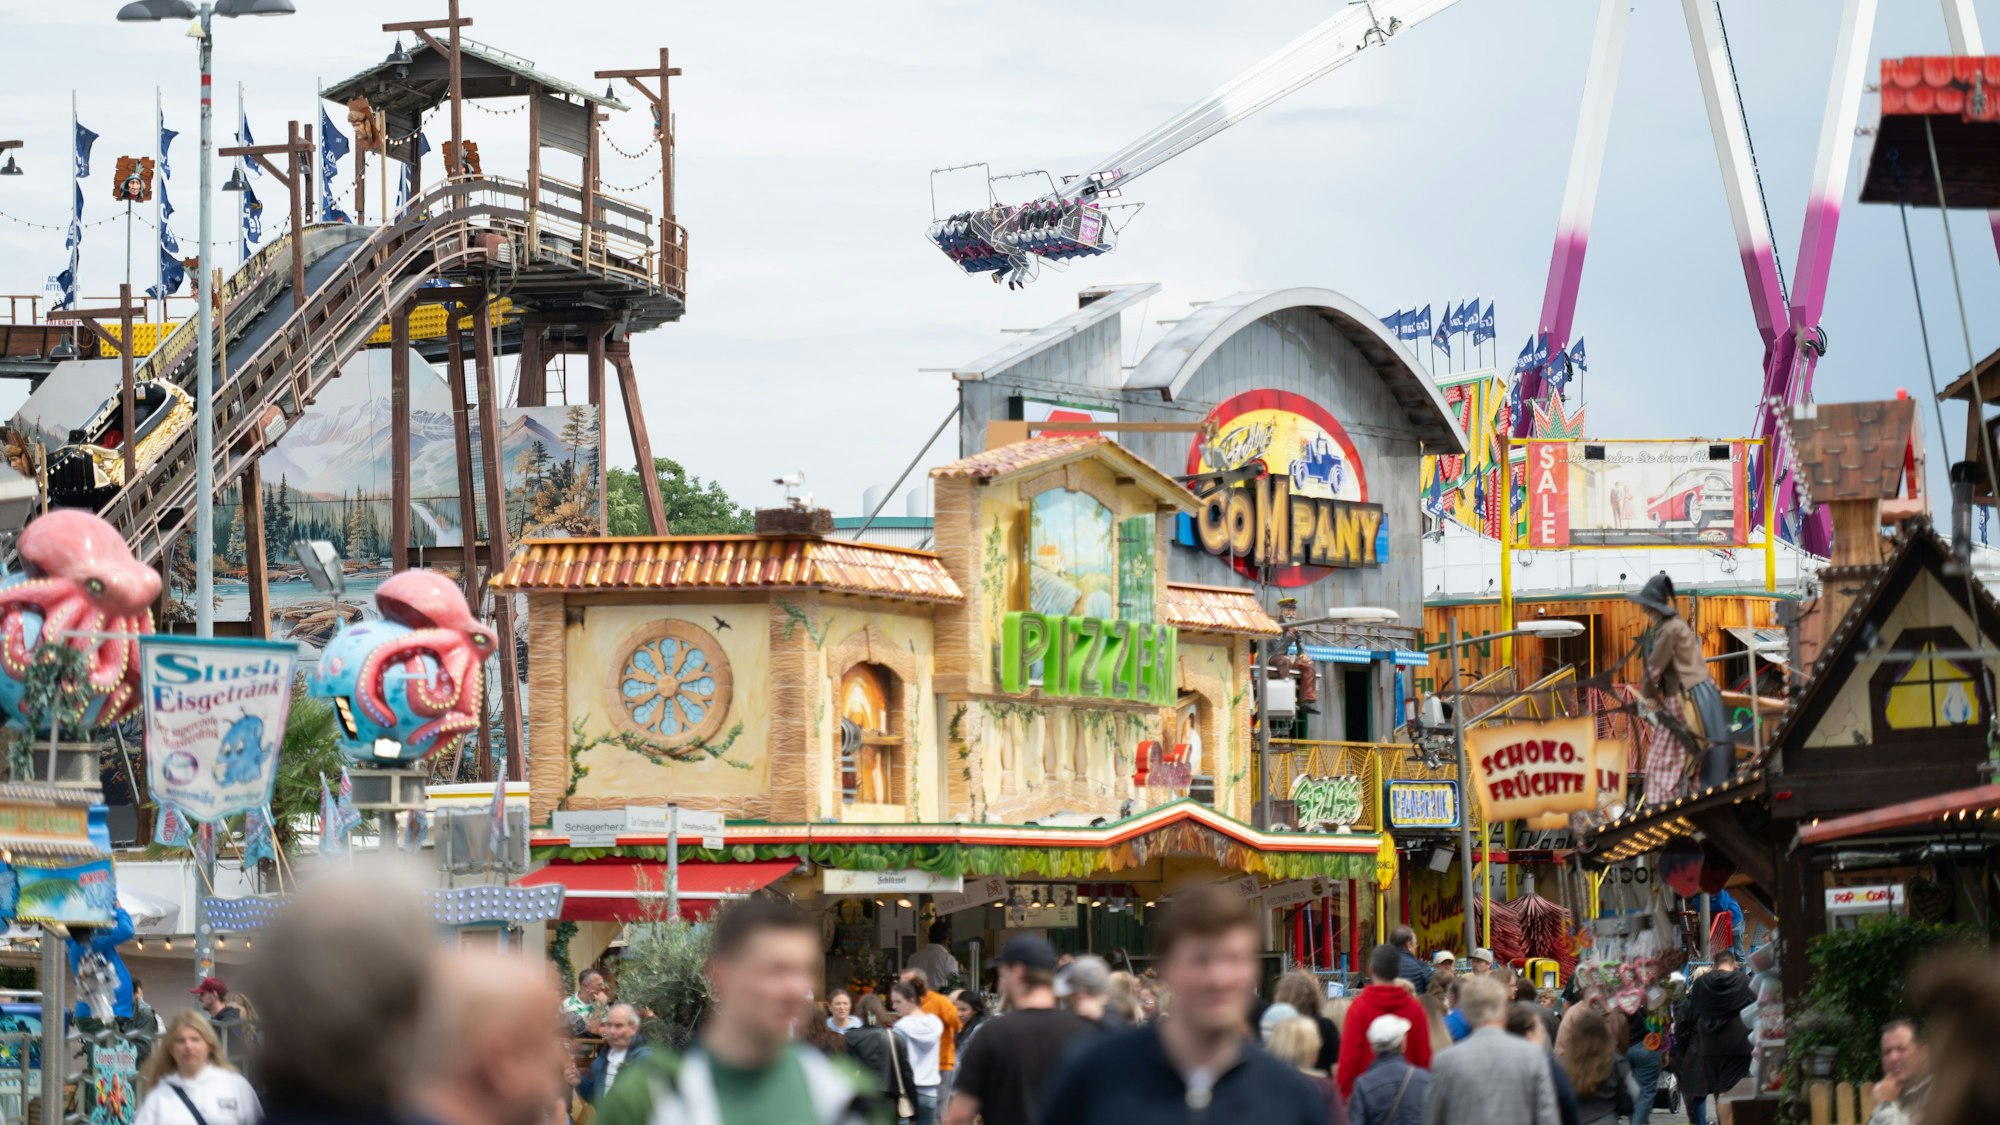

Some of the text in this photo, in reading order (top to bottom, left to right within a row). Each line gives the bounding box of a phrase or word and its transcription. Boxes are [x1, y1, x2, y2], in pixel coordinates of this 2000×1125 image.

[1536, 444, 1558, 544] SALE
[1196, 474, 1382, 567] COMPANY
[155, 653, 280, 684] Slush
[152, 678, 280, 714] Eisgetränk
[1481, 740, 1584, 777] SCHOKO-
[1488, 769, 1585, 802] FRÜCHTE
[564, 822, 625, 835] Schlagerherz
